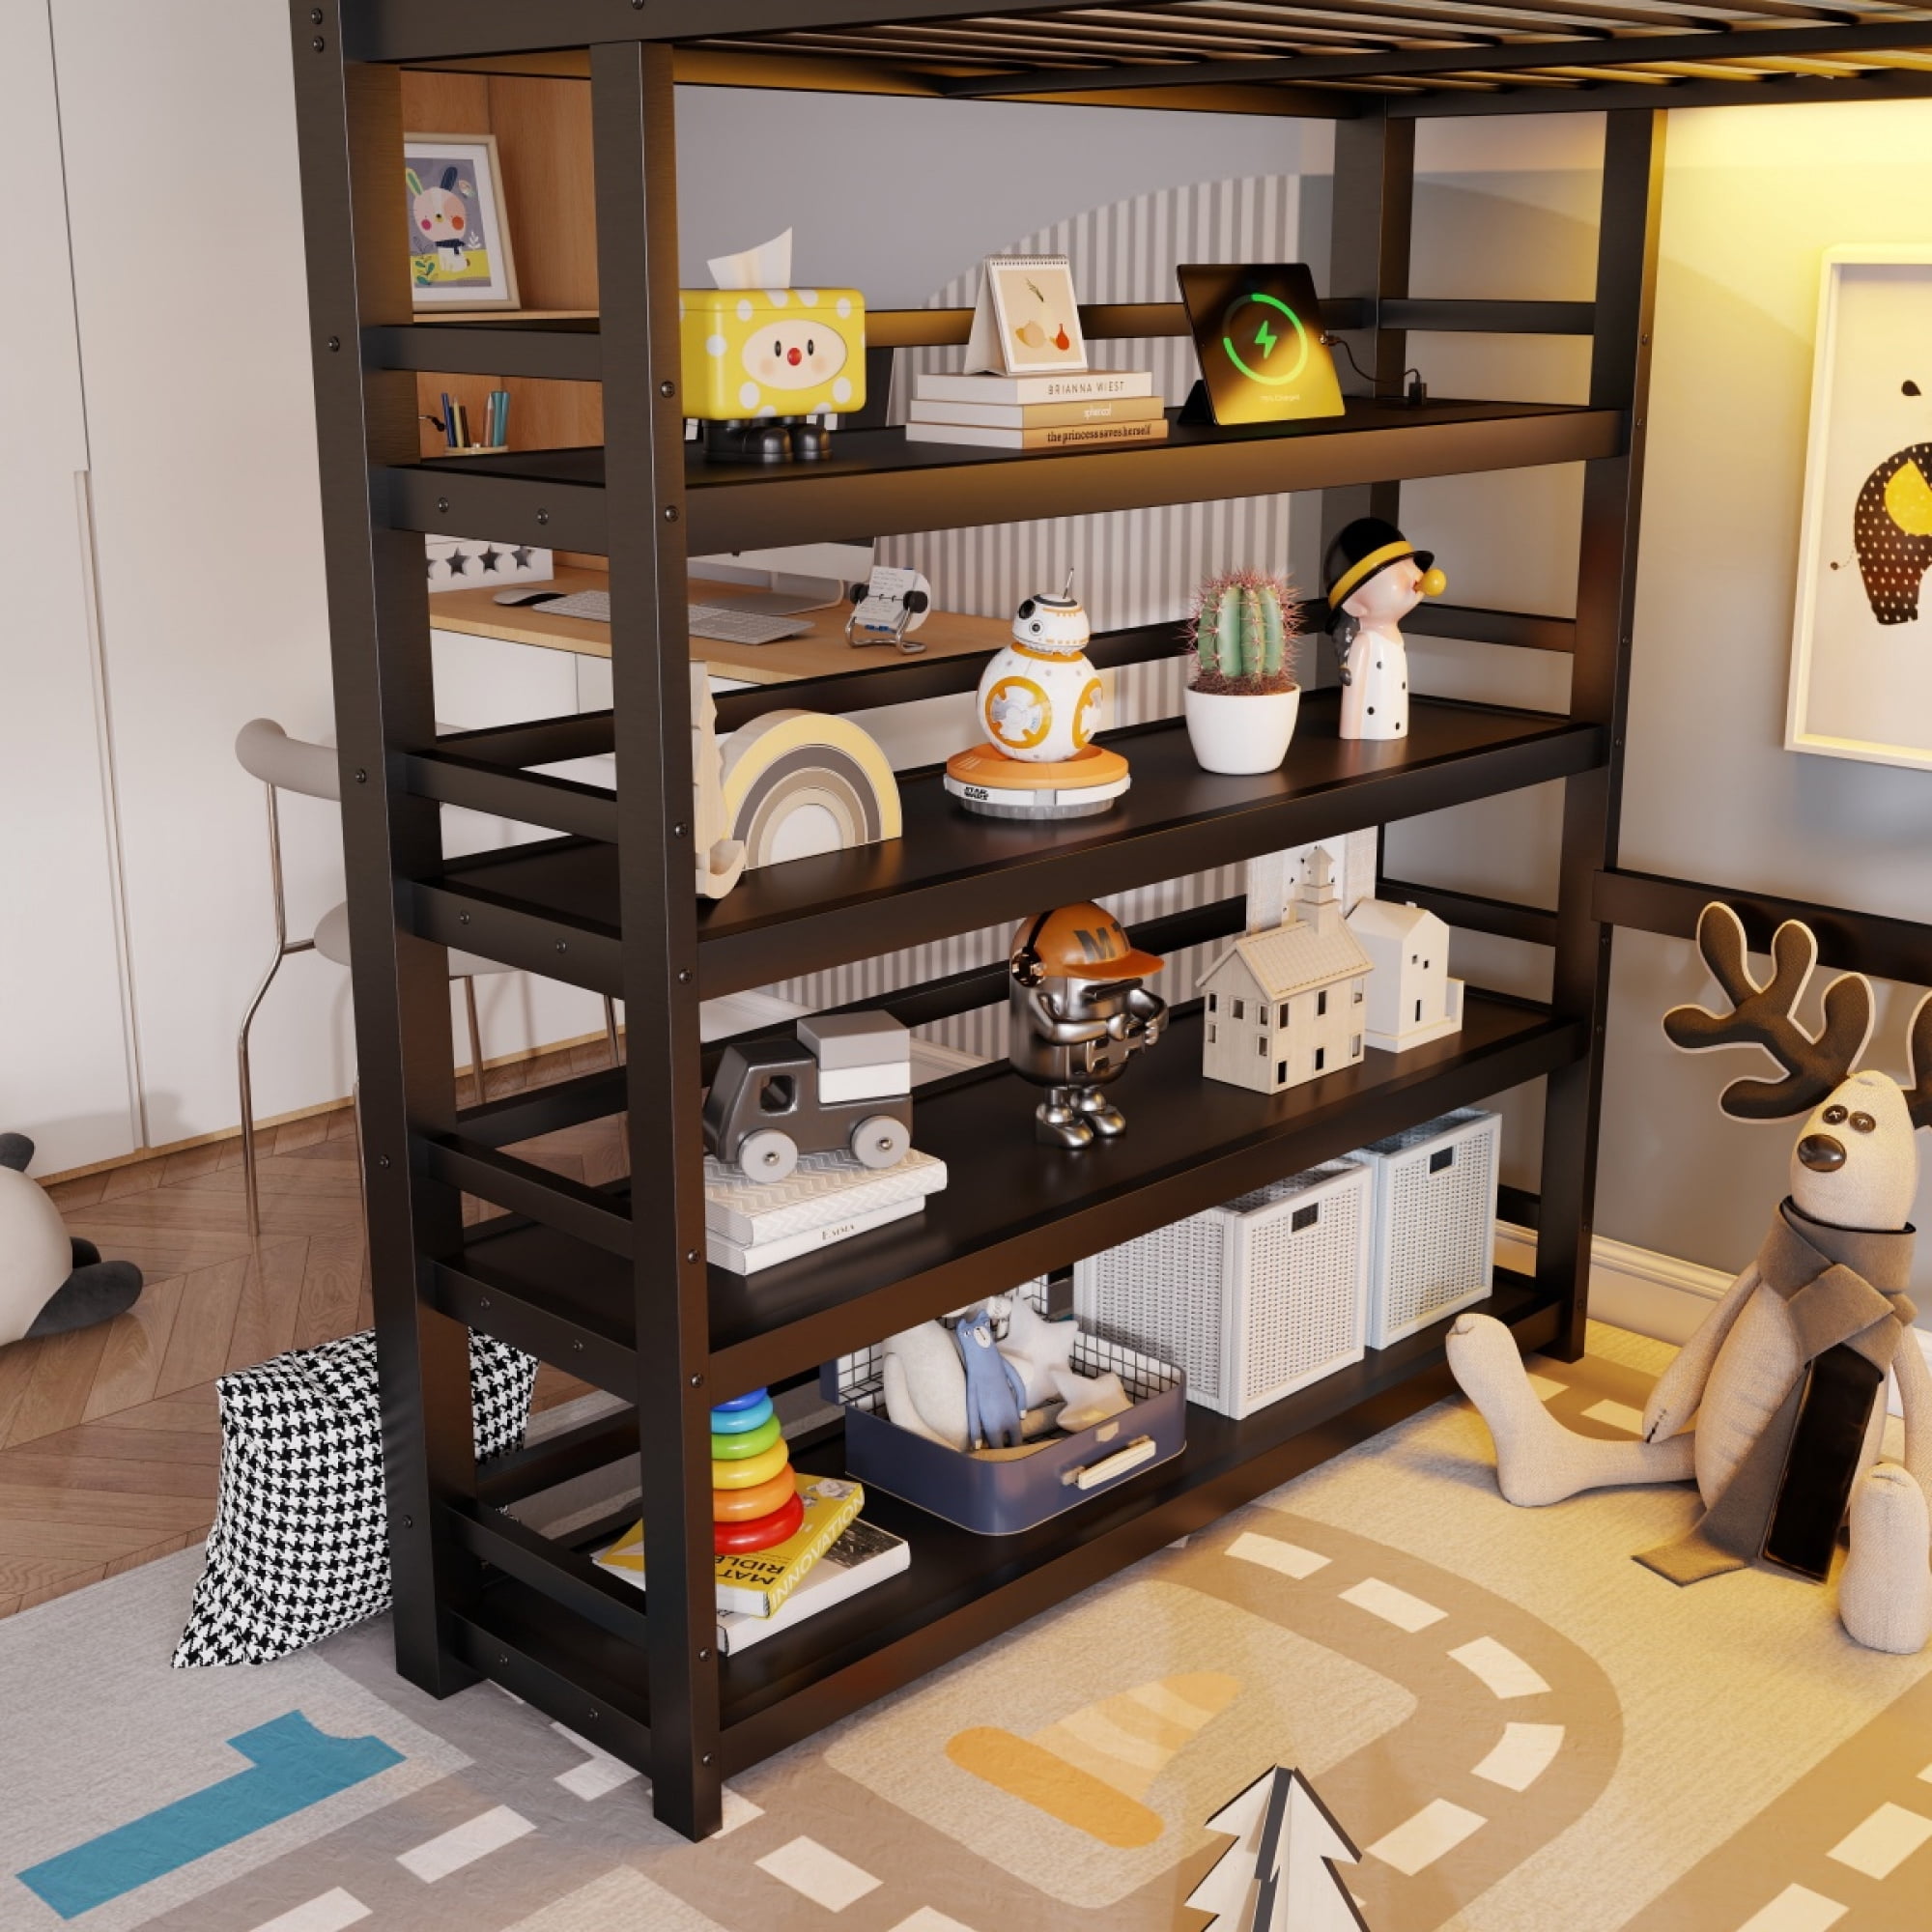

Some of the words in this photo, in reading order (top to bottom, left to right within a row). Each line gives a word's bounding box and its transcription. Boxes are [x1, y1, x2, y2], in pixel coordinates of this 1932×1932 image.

[1048, 383, 1093, 395] BRIANNA
[1095, 381, 1124, 392] WIEST
[1047, 431, 1062, 442] the
[1063, 429, 1098, 444] princess
[1099, 428, 1122, 440] saves
[1122, 423, 1152, 438] herself
[770, 1487, 866, 1610] INNOVATION
